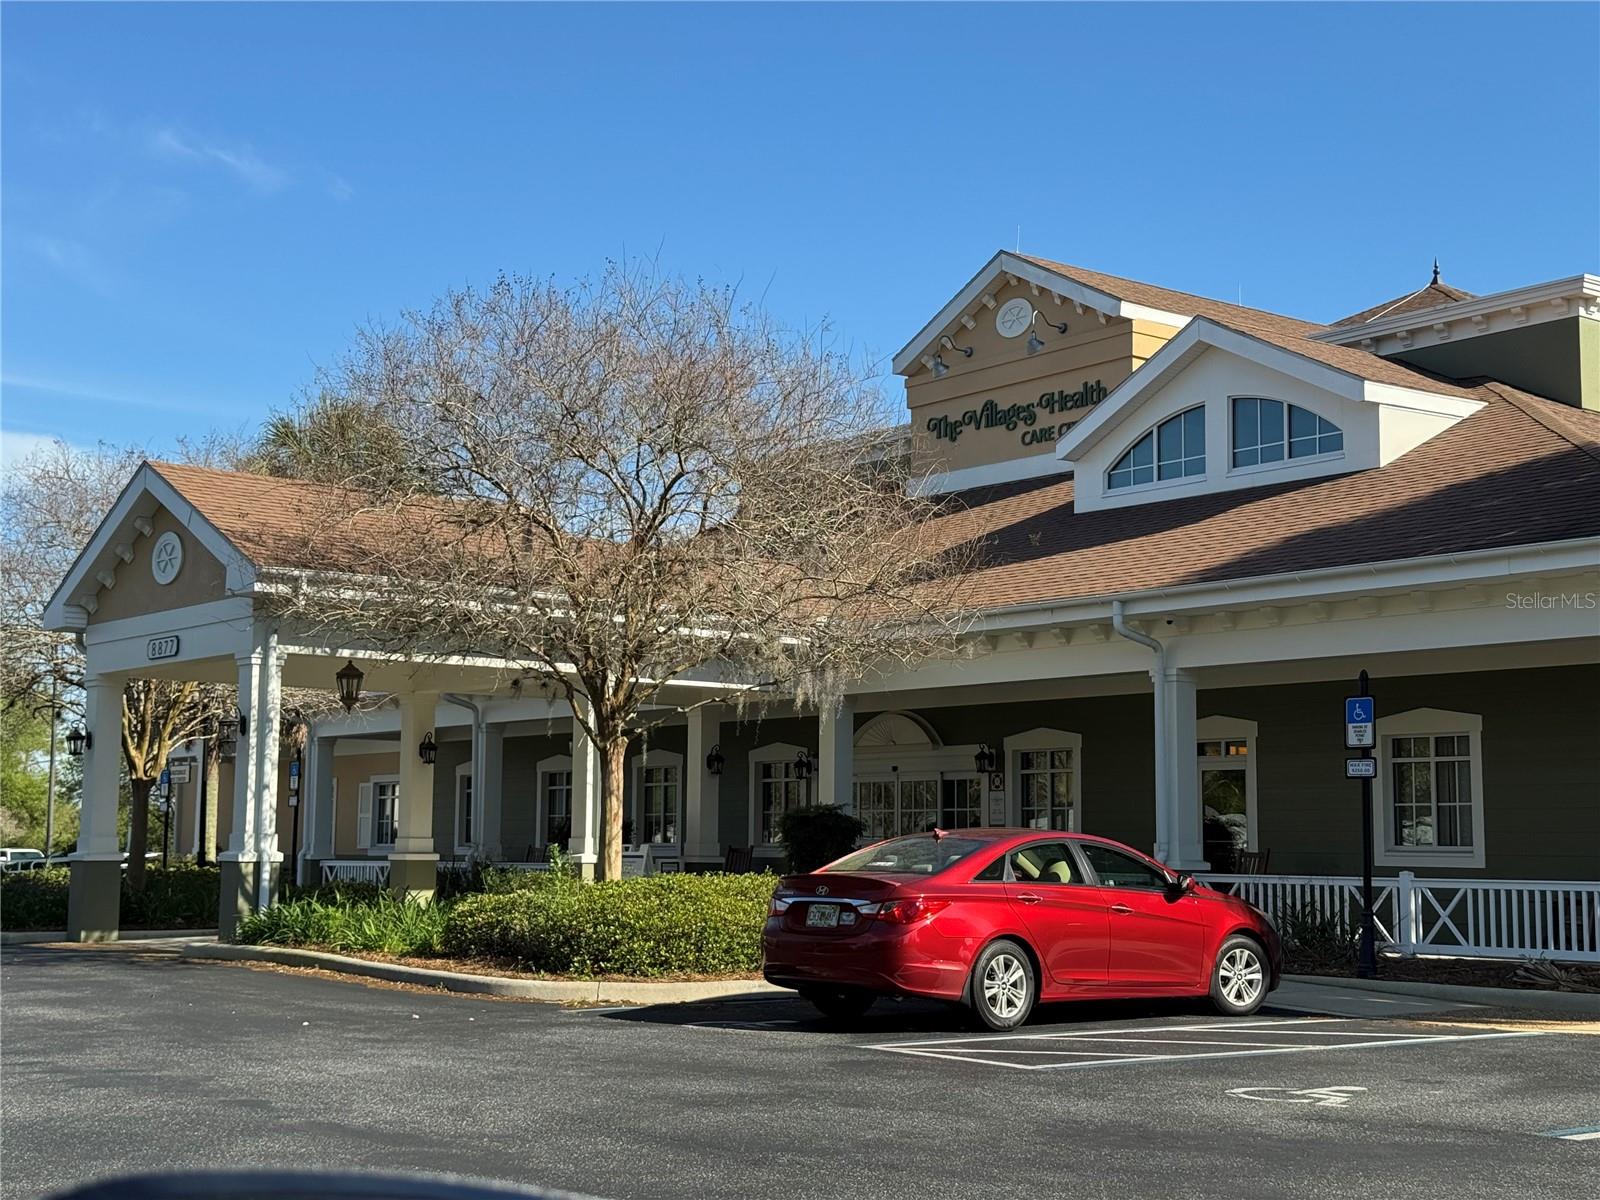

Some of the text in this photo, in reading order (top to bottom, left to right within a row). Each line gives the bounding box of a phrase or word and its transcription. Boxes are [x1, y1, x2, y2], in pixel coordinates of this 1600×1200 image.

[927, 379, 1108, 442] The Villages Health
[1021, 426, 1055, 446] CARE
[151, 639, 175, 656] 8877
